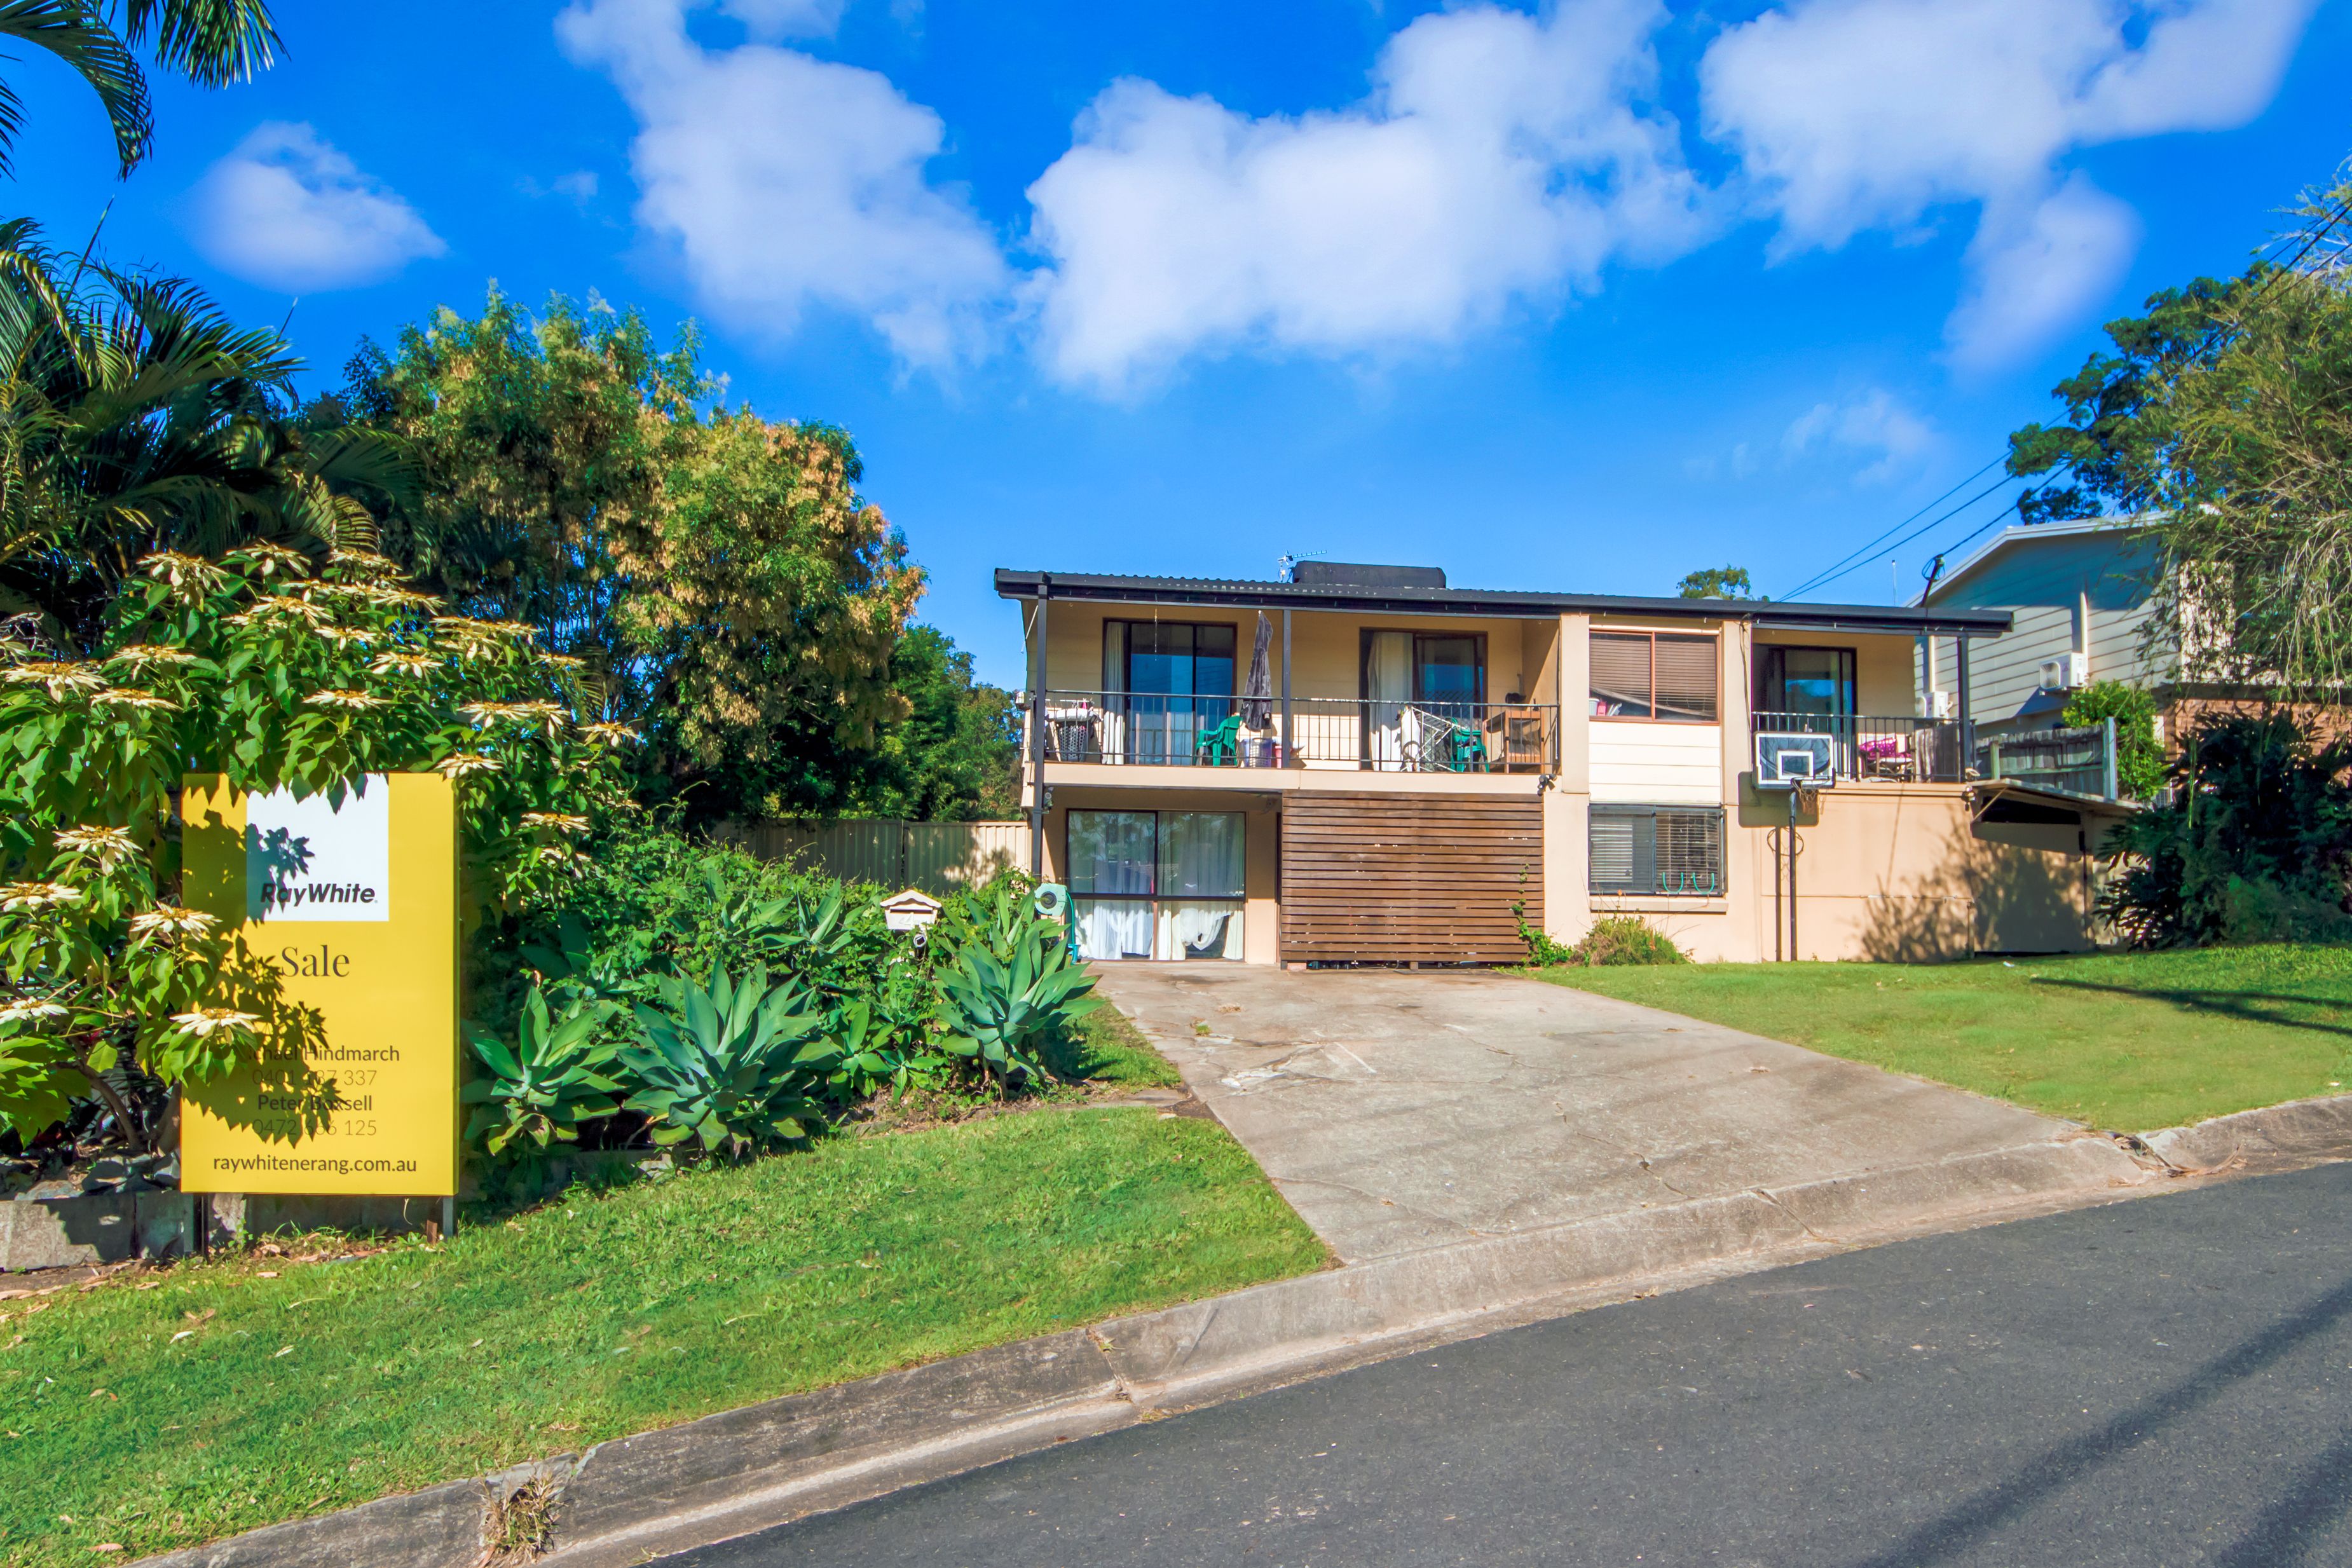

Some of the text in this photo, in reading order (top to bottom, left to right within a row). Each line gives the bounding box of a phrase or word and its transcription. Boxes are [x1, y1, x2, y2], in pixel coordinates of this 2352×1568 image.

[281, 944, 350, 978] Sale
[304, 1046, 400, 1061] Hindmarch
[252, 1070, 297, 1086] 0401
[344, 1070, 378, 1086] 337
[258, 1094, 372, 1111] Peter Boxsell
[252, 1119, 377, 1136] 0472 666 125
[213, 1154, 417, 1175] raywhitenerang.com.au
